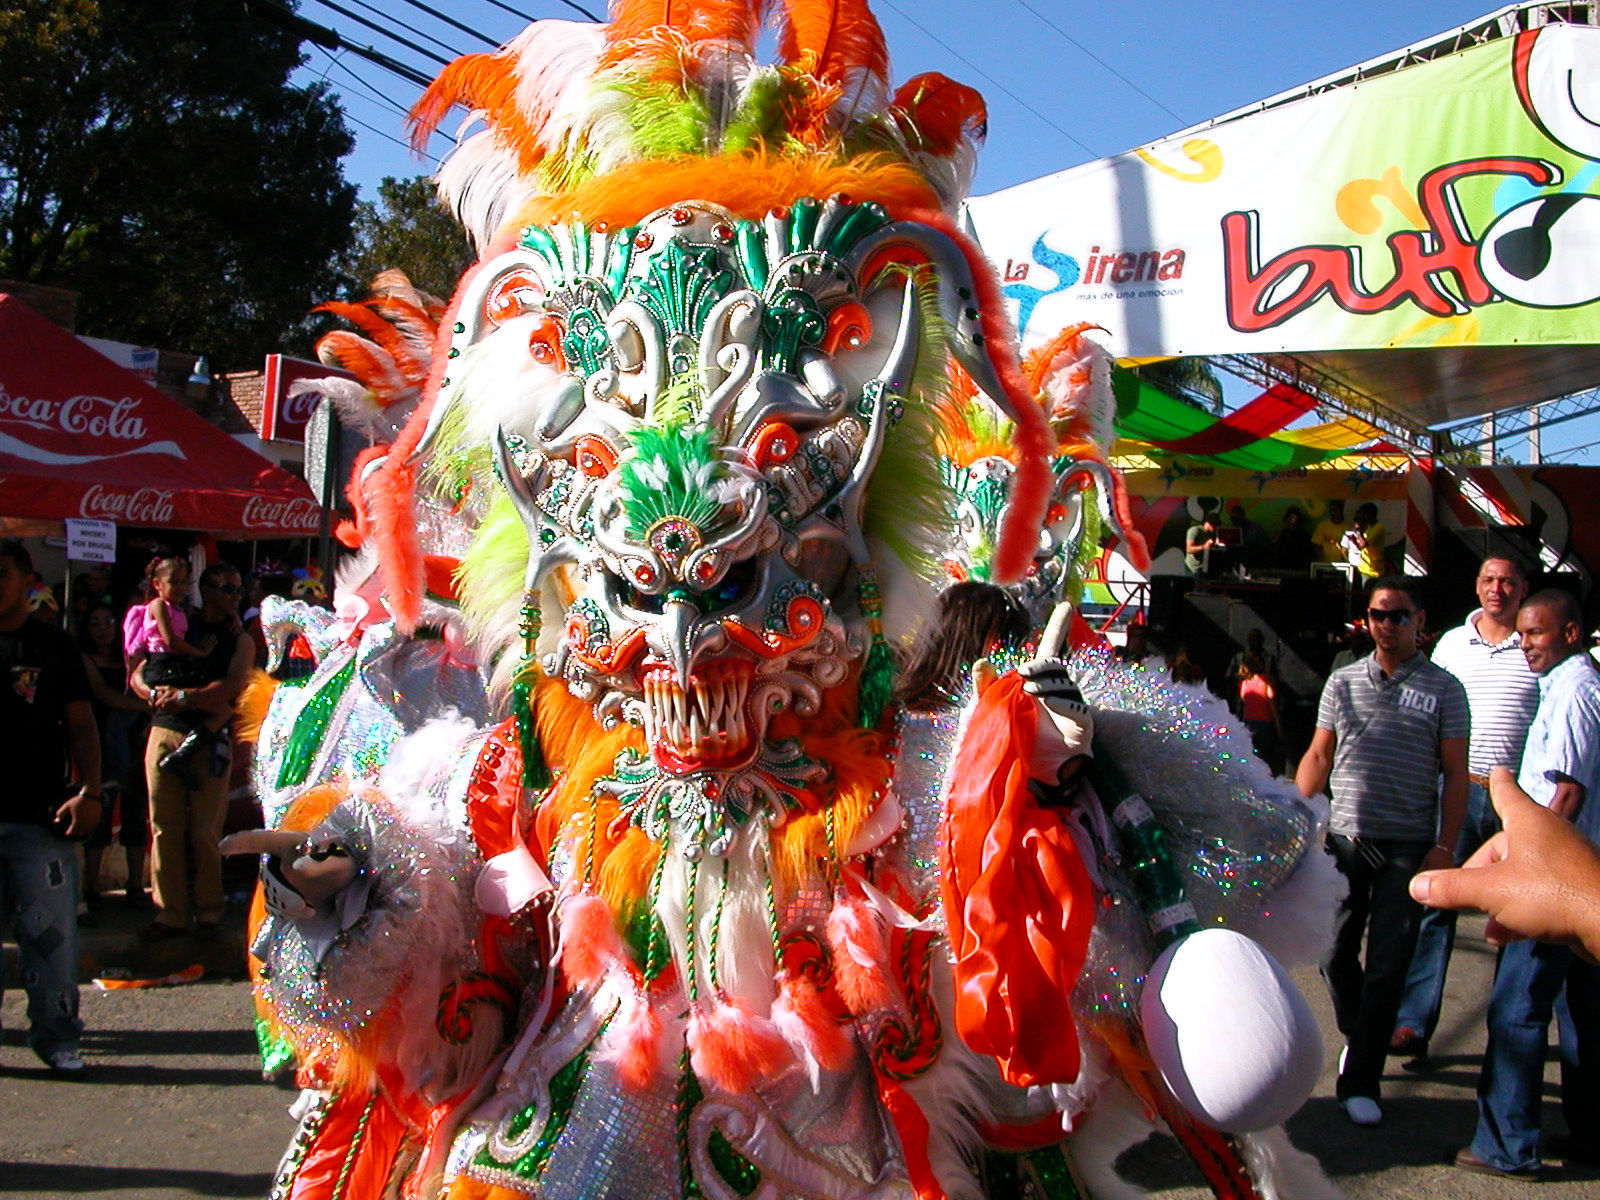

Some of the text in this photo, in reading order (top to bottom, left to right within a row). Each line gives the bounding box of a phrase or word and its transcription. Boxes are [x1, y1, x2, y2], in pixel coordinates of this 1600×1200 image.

[1003, 258, 1030, 283] La
[1116, 290, 1136, 299] una
[0, 382, 147, 439] oca-Cola
[80, 484, 176, 522] Coca-Cola
[1399, 688, 1438, 714] HCO
